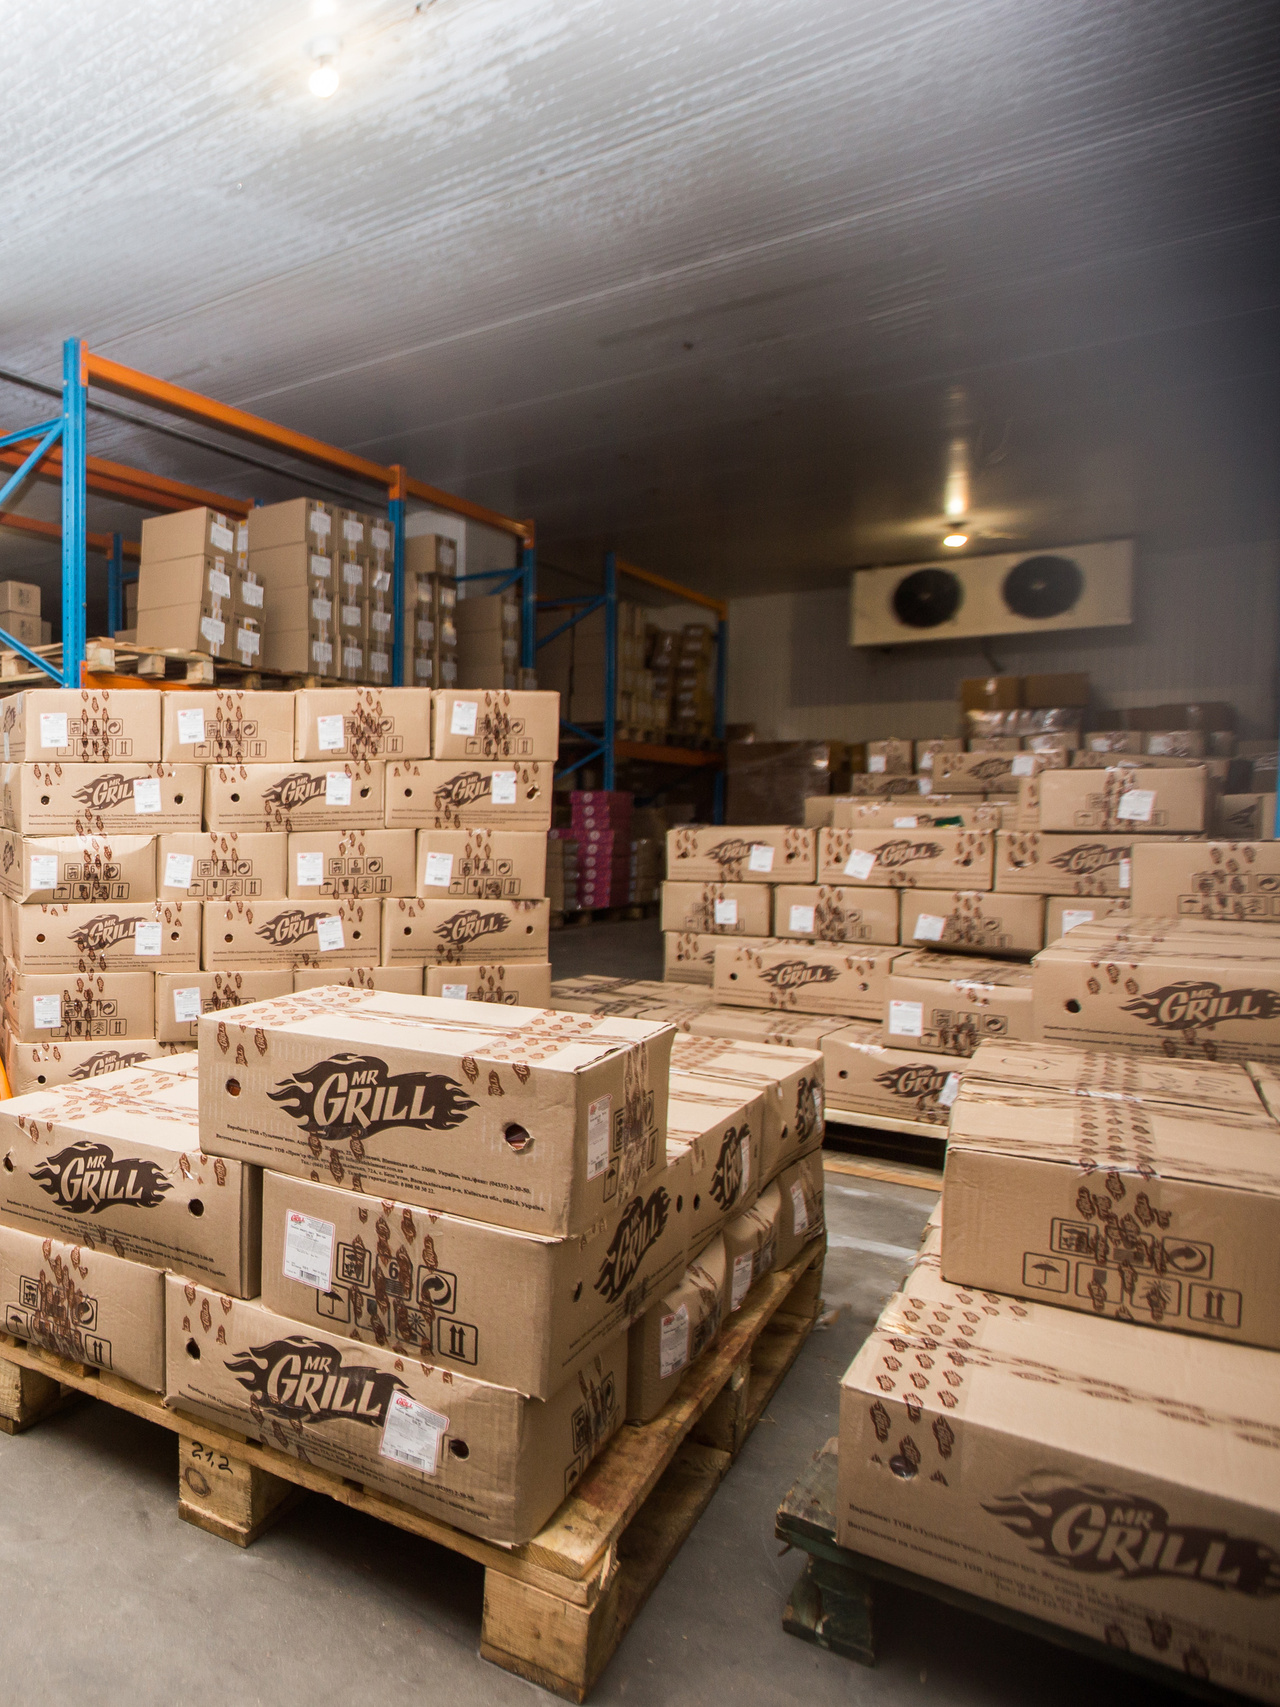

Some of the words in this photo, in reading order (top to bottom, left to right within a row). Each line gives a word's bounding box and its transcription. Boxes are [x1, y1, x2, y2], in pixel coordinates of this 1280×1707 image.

[452, 917, 499, 940] GRILL
[777, 966, 827, 985] GRILL
[1159, 991, 1261, 1023] GRILL
[351, 1070, 379, 1086] MR
[313, 1072, 436, 1129] GRILL
[86, 1155, 107, 1169] MR
[60, 1157, 143, 1205] GRILL
[389, 1261, 399, 1280] 6
[303, 1355, 332, 1376] MR
[267, 1357, 382, 1417] GRILL
[1111, 1507, 1155, 1530] MR
[1051, 1503, 1241, 1583] GRILL
